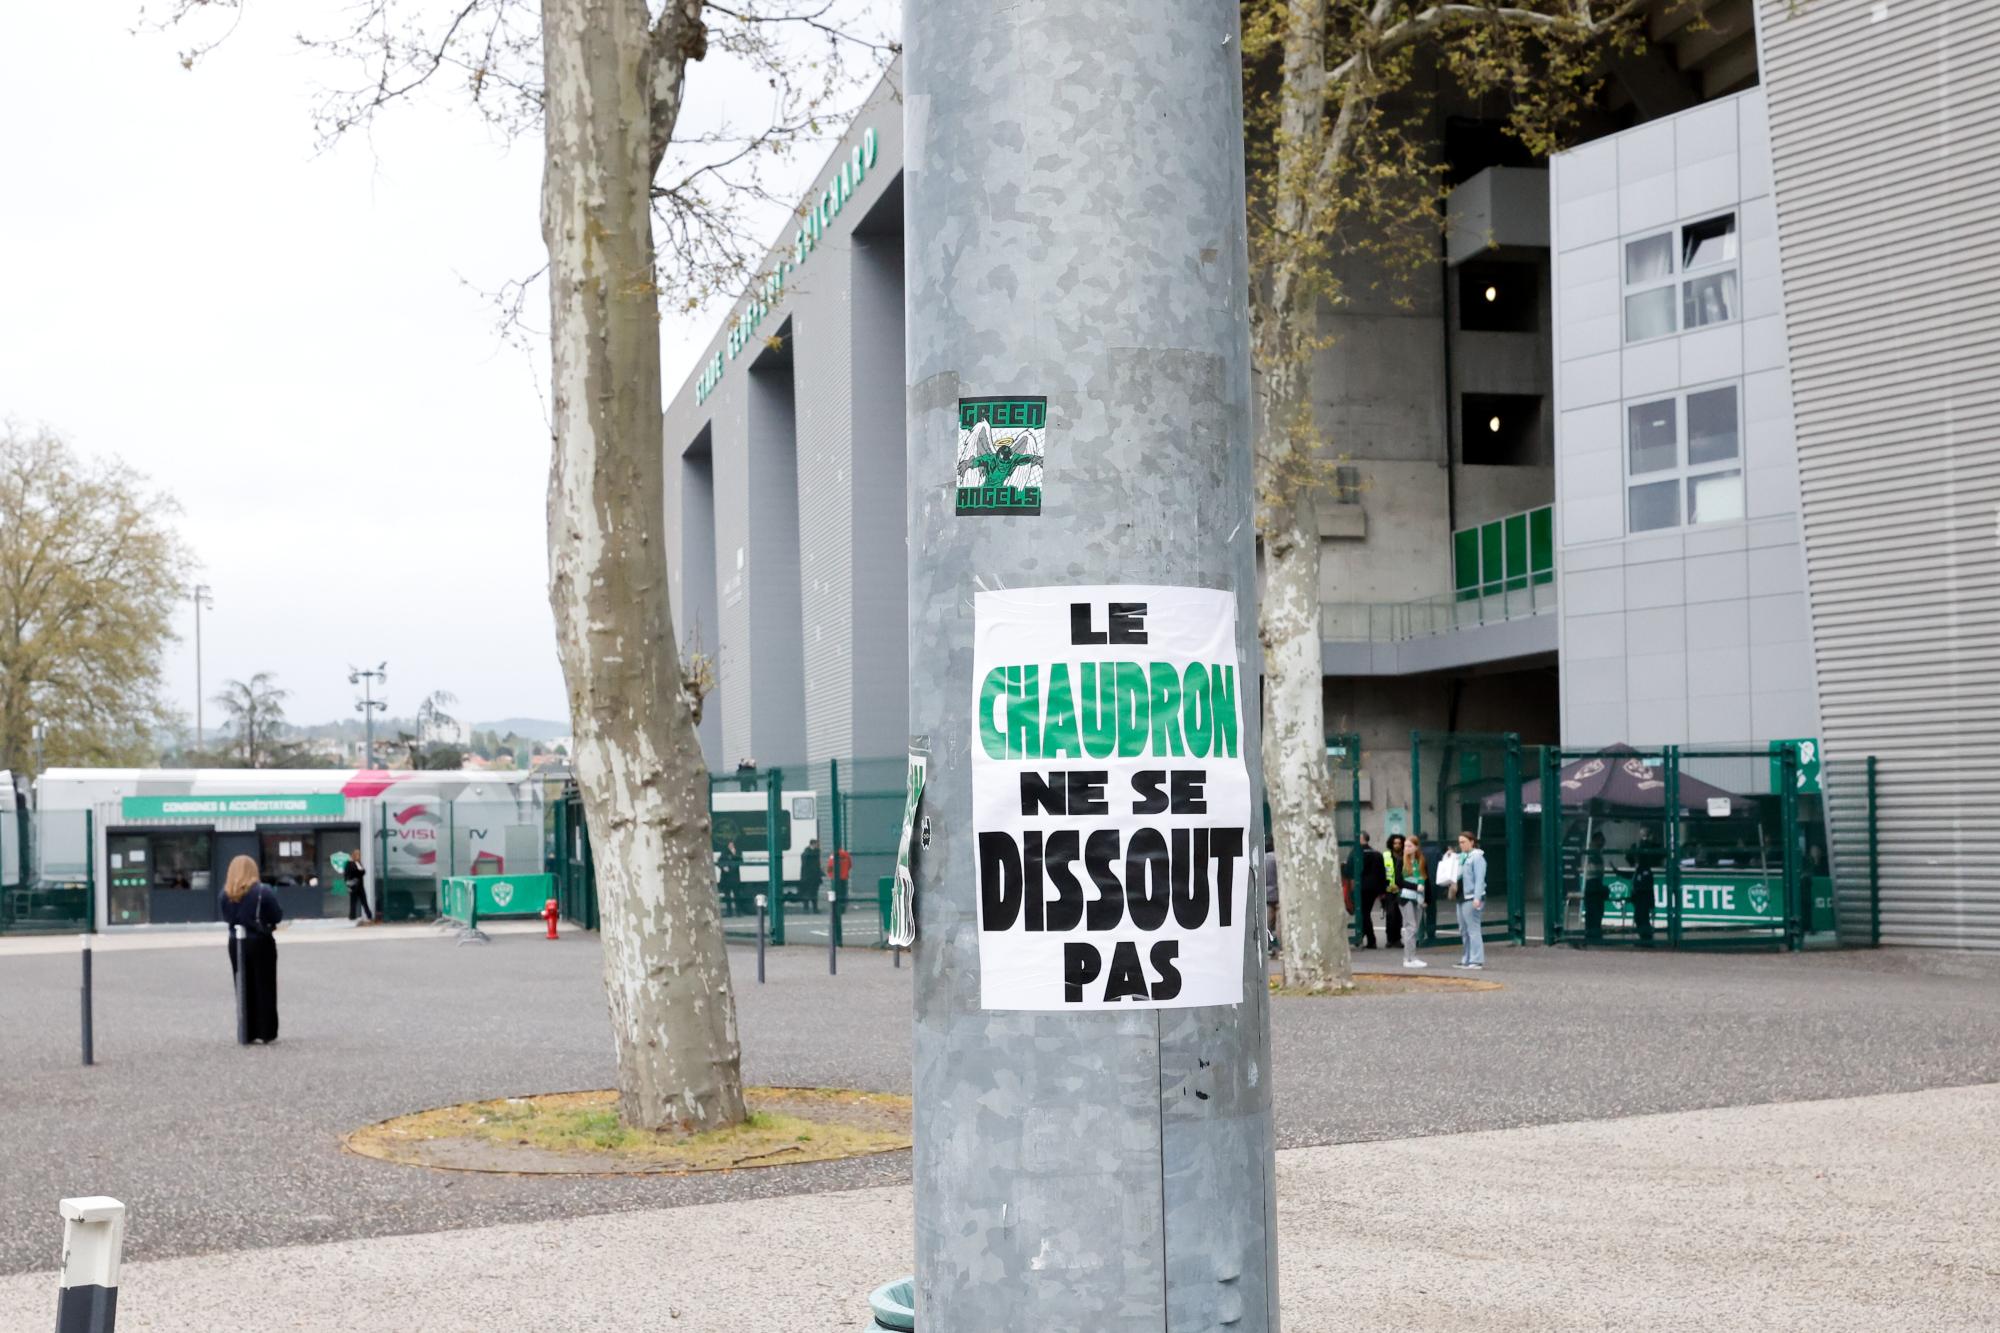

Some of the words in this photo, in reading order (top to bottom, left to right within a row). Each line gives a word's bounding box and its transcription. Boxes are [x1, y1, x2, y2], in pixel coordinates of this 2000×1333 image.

[961, 402, 1044, 429] GREEN
[958, 486, 1040, 508] ANGELS
[1070, 603, 1148, 646] LE
[979, 662, 1238, 760] CHAUDRON
[1020, 771, 1109, 816] NE
[1131, 770, 1207, 815] SE
[978, 827, 1244, 932] DISSOUT
[1064, 940, 1182, 1003] PAS
